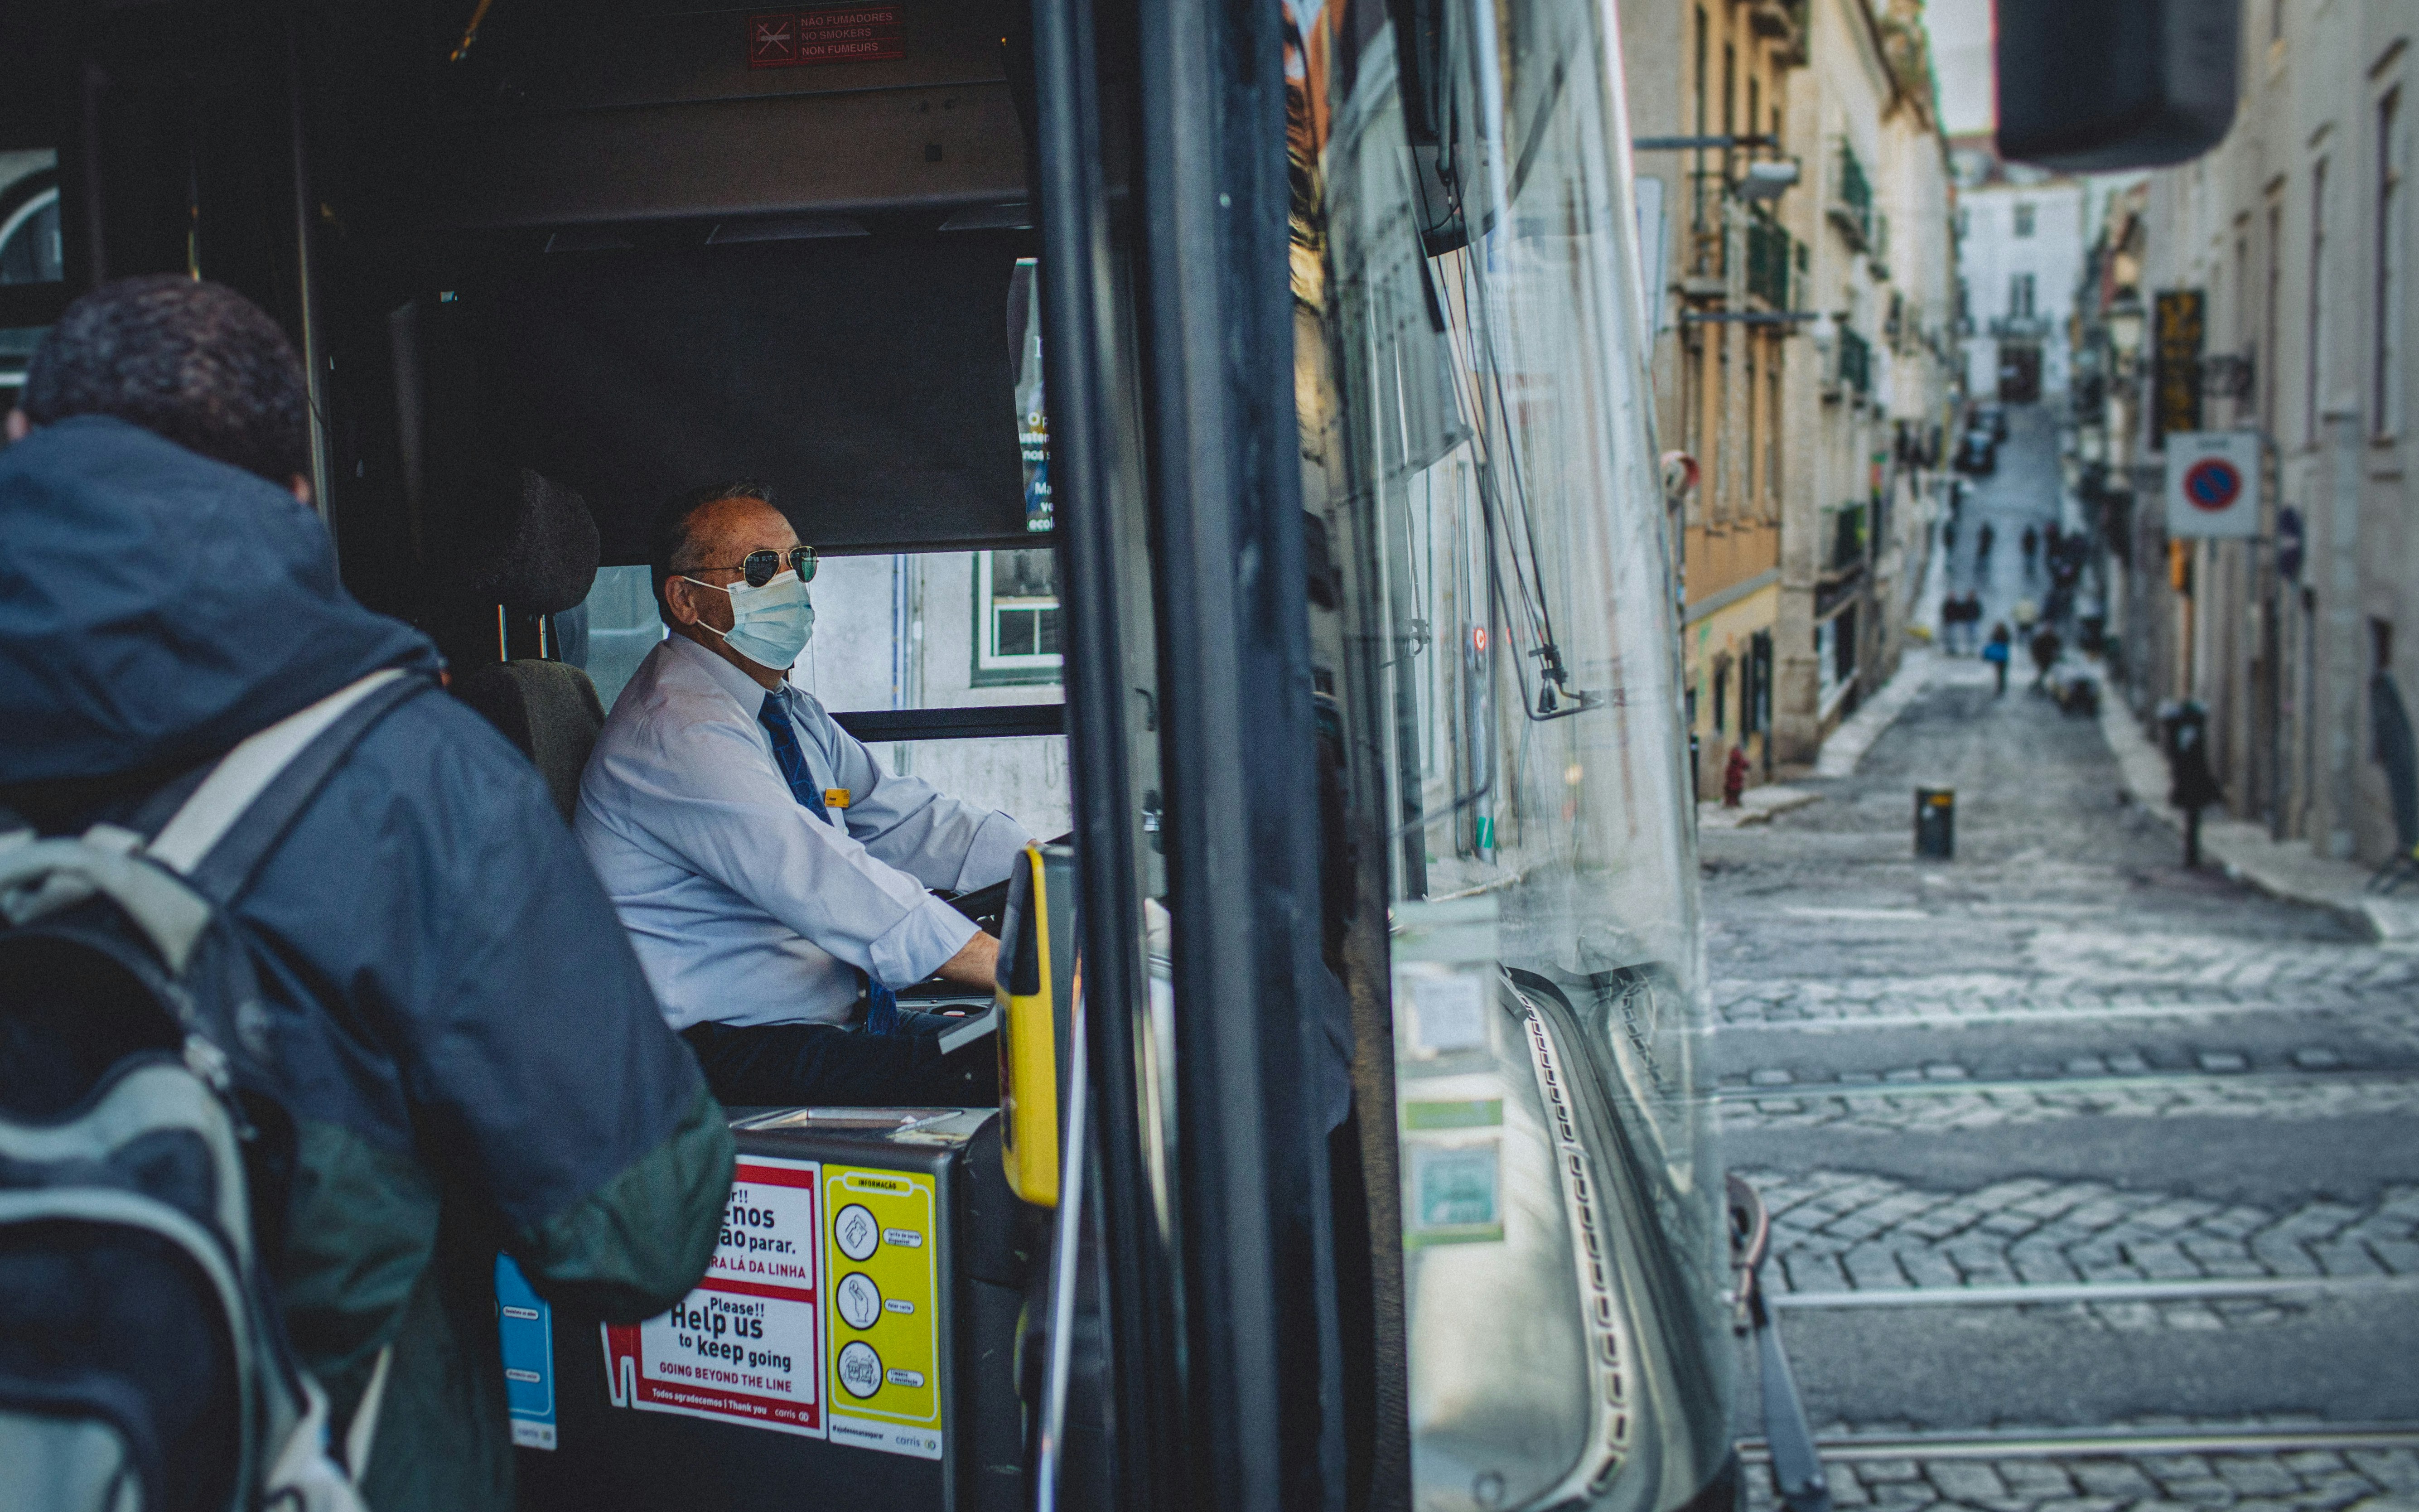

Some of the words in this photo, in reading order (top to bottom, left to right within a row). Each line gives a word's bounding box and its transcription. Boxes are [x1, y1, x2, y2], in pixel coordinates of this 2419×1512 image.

[801, 15, 824, 26] NÃO
[827, 12, 893, 25] FUMADORES
[802, 31, 816, 40] NO
[820, 28, 872, 39] SMOKERS
[802, 46, 825, 56] NON
[828, 43, 879, 54] FUMEURS
[1019, 431, 1049, 444] usten
[1035, 482, 1052, 495] Ma
[1040, 502, 1054, 513] ve
[1028, 516, 1054, 530] ecol
[859, 1179, 897, 1190] INFORMAÇÃO
[729, 1189, 748, 1203] r!!
[720, 1223, 746, 1248] ão
[749, 1237, 796, 1254] parar.
[711, 1255, 727, 1269] RA
[730, 1255, 745, 1271] LÁ
[749, 1260, 765, 1274] DA
[768, 1262, 806, 1279] LINHA
[710, 1297, 764, 1317] Please!!
[671, 1302, 726, 1339] Help
[734, 1316, 763, 1339] us
[680, 1333, 692, 1348] to
[697, 1335, 744, 1365] keep
[748, 1350, 791, 1372] going
[660, 1362, 692, 1377] GOING
[695, 1367, 739, 1384] BEYOND
[741, 1374, 763, 1388] THE
[766, 1378, 792, 1393] LINE
[652, 1387, 674, 1400] Todos
[674, 1392, 723, 1408] agradecemos
[728, 1399, 752, 1412] Thank
[753, 1405, 768, 1415] you
[775, 1408, 796, 1419] carris
